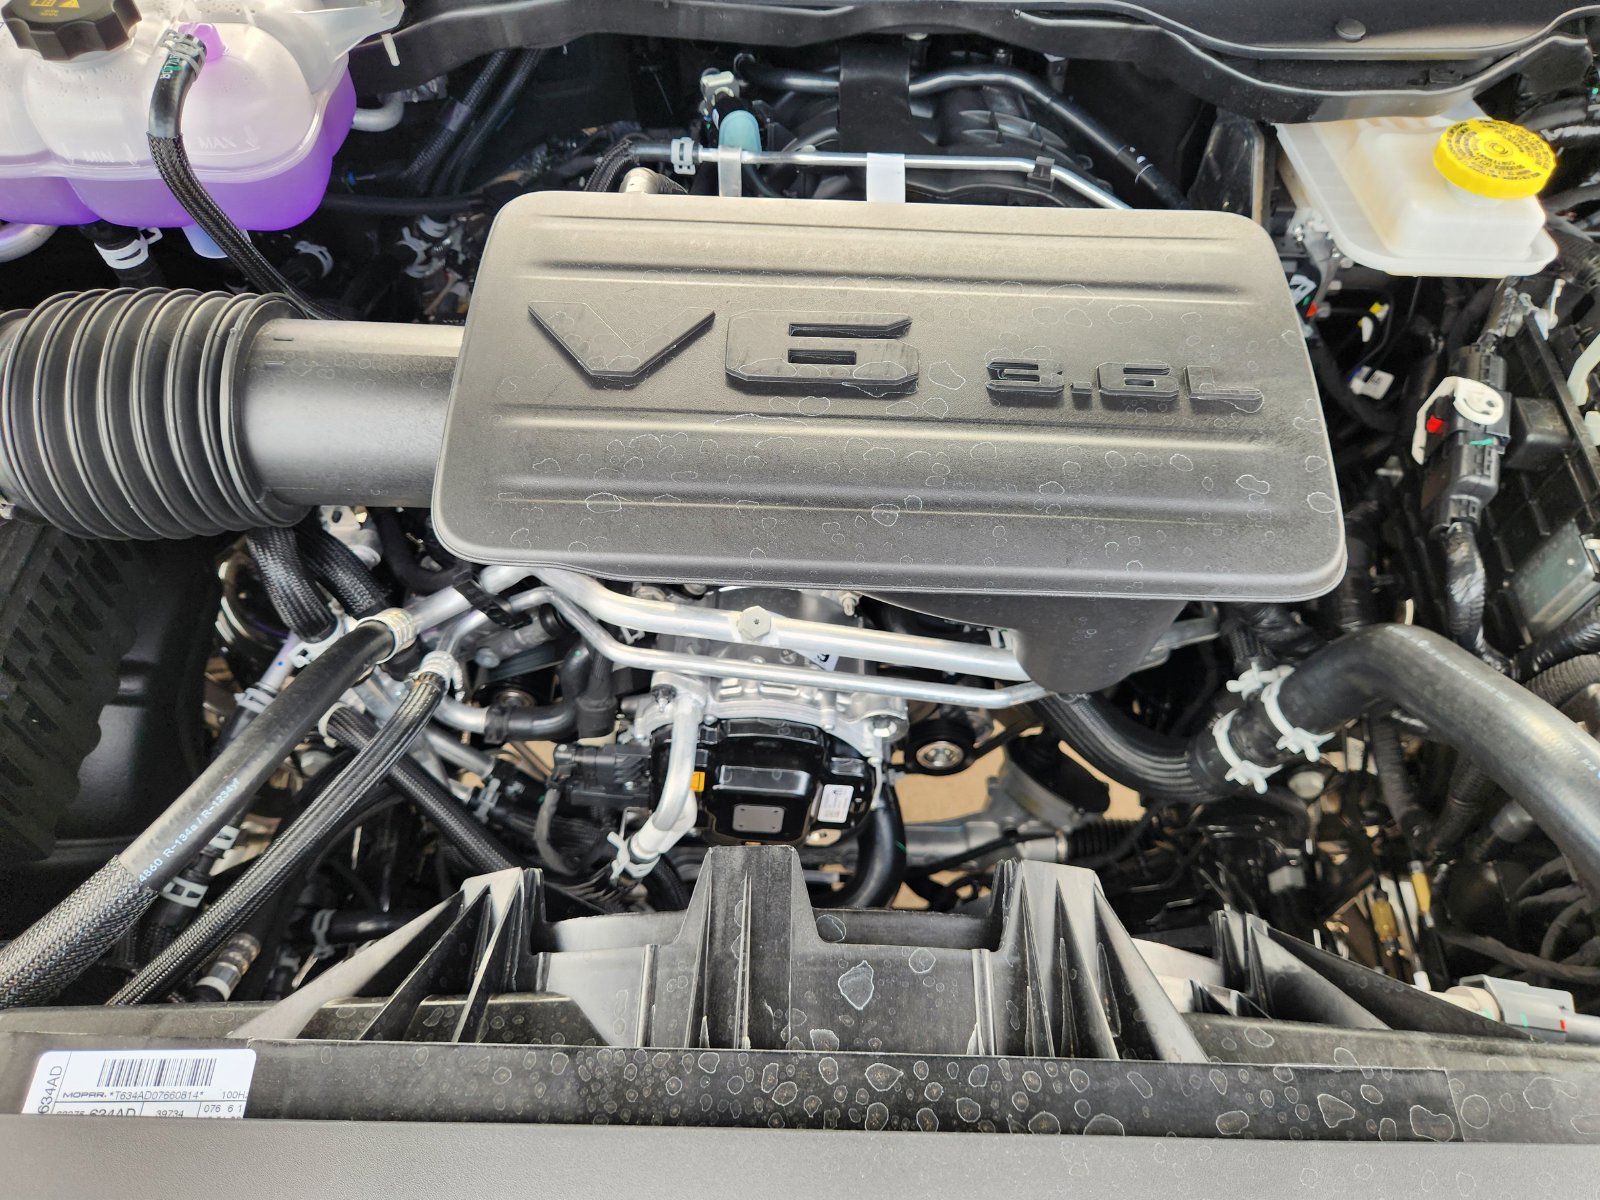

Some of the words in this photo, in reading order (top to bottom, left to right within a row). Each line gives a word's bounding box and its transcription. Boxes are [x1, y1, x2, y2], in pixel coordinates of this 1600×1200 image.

[83, 151, 114, 163] MIN
[198, 136, 237, 149] MAX
[527, 301, 919, 390] V6
[985, 357, 1264, 404] 3.6L
[37, 1065, 63, 1114] 634AD
